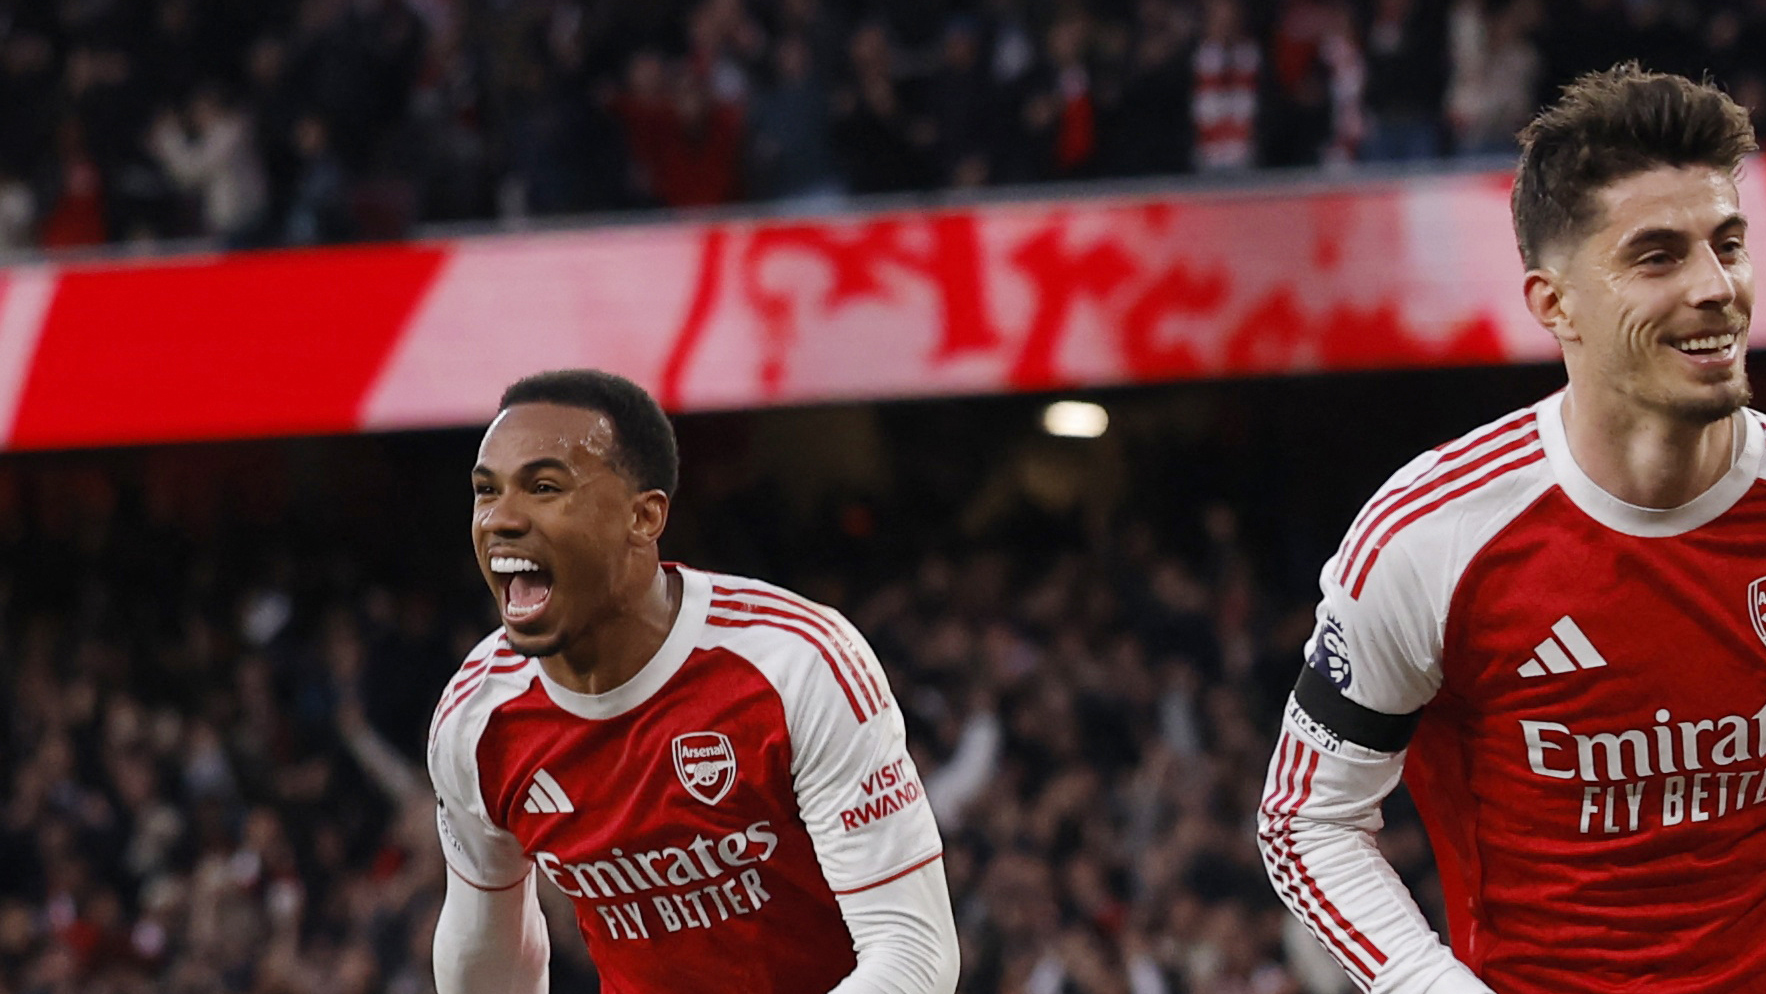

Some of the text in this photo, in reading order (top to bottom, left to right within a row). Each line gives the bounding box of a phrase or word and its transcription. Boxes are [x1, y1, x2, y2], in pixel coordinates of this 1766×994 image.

[681, 743, 726, 759] Arsenal
[860, 758, 906, 796] VISIT
[1579, 779, 1642, 834] FLY
[532, 819, 779, 900] Emirates
[597, 867, 771, 941] FLY BETTER
